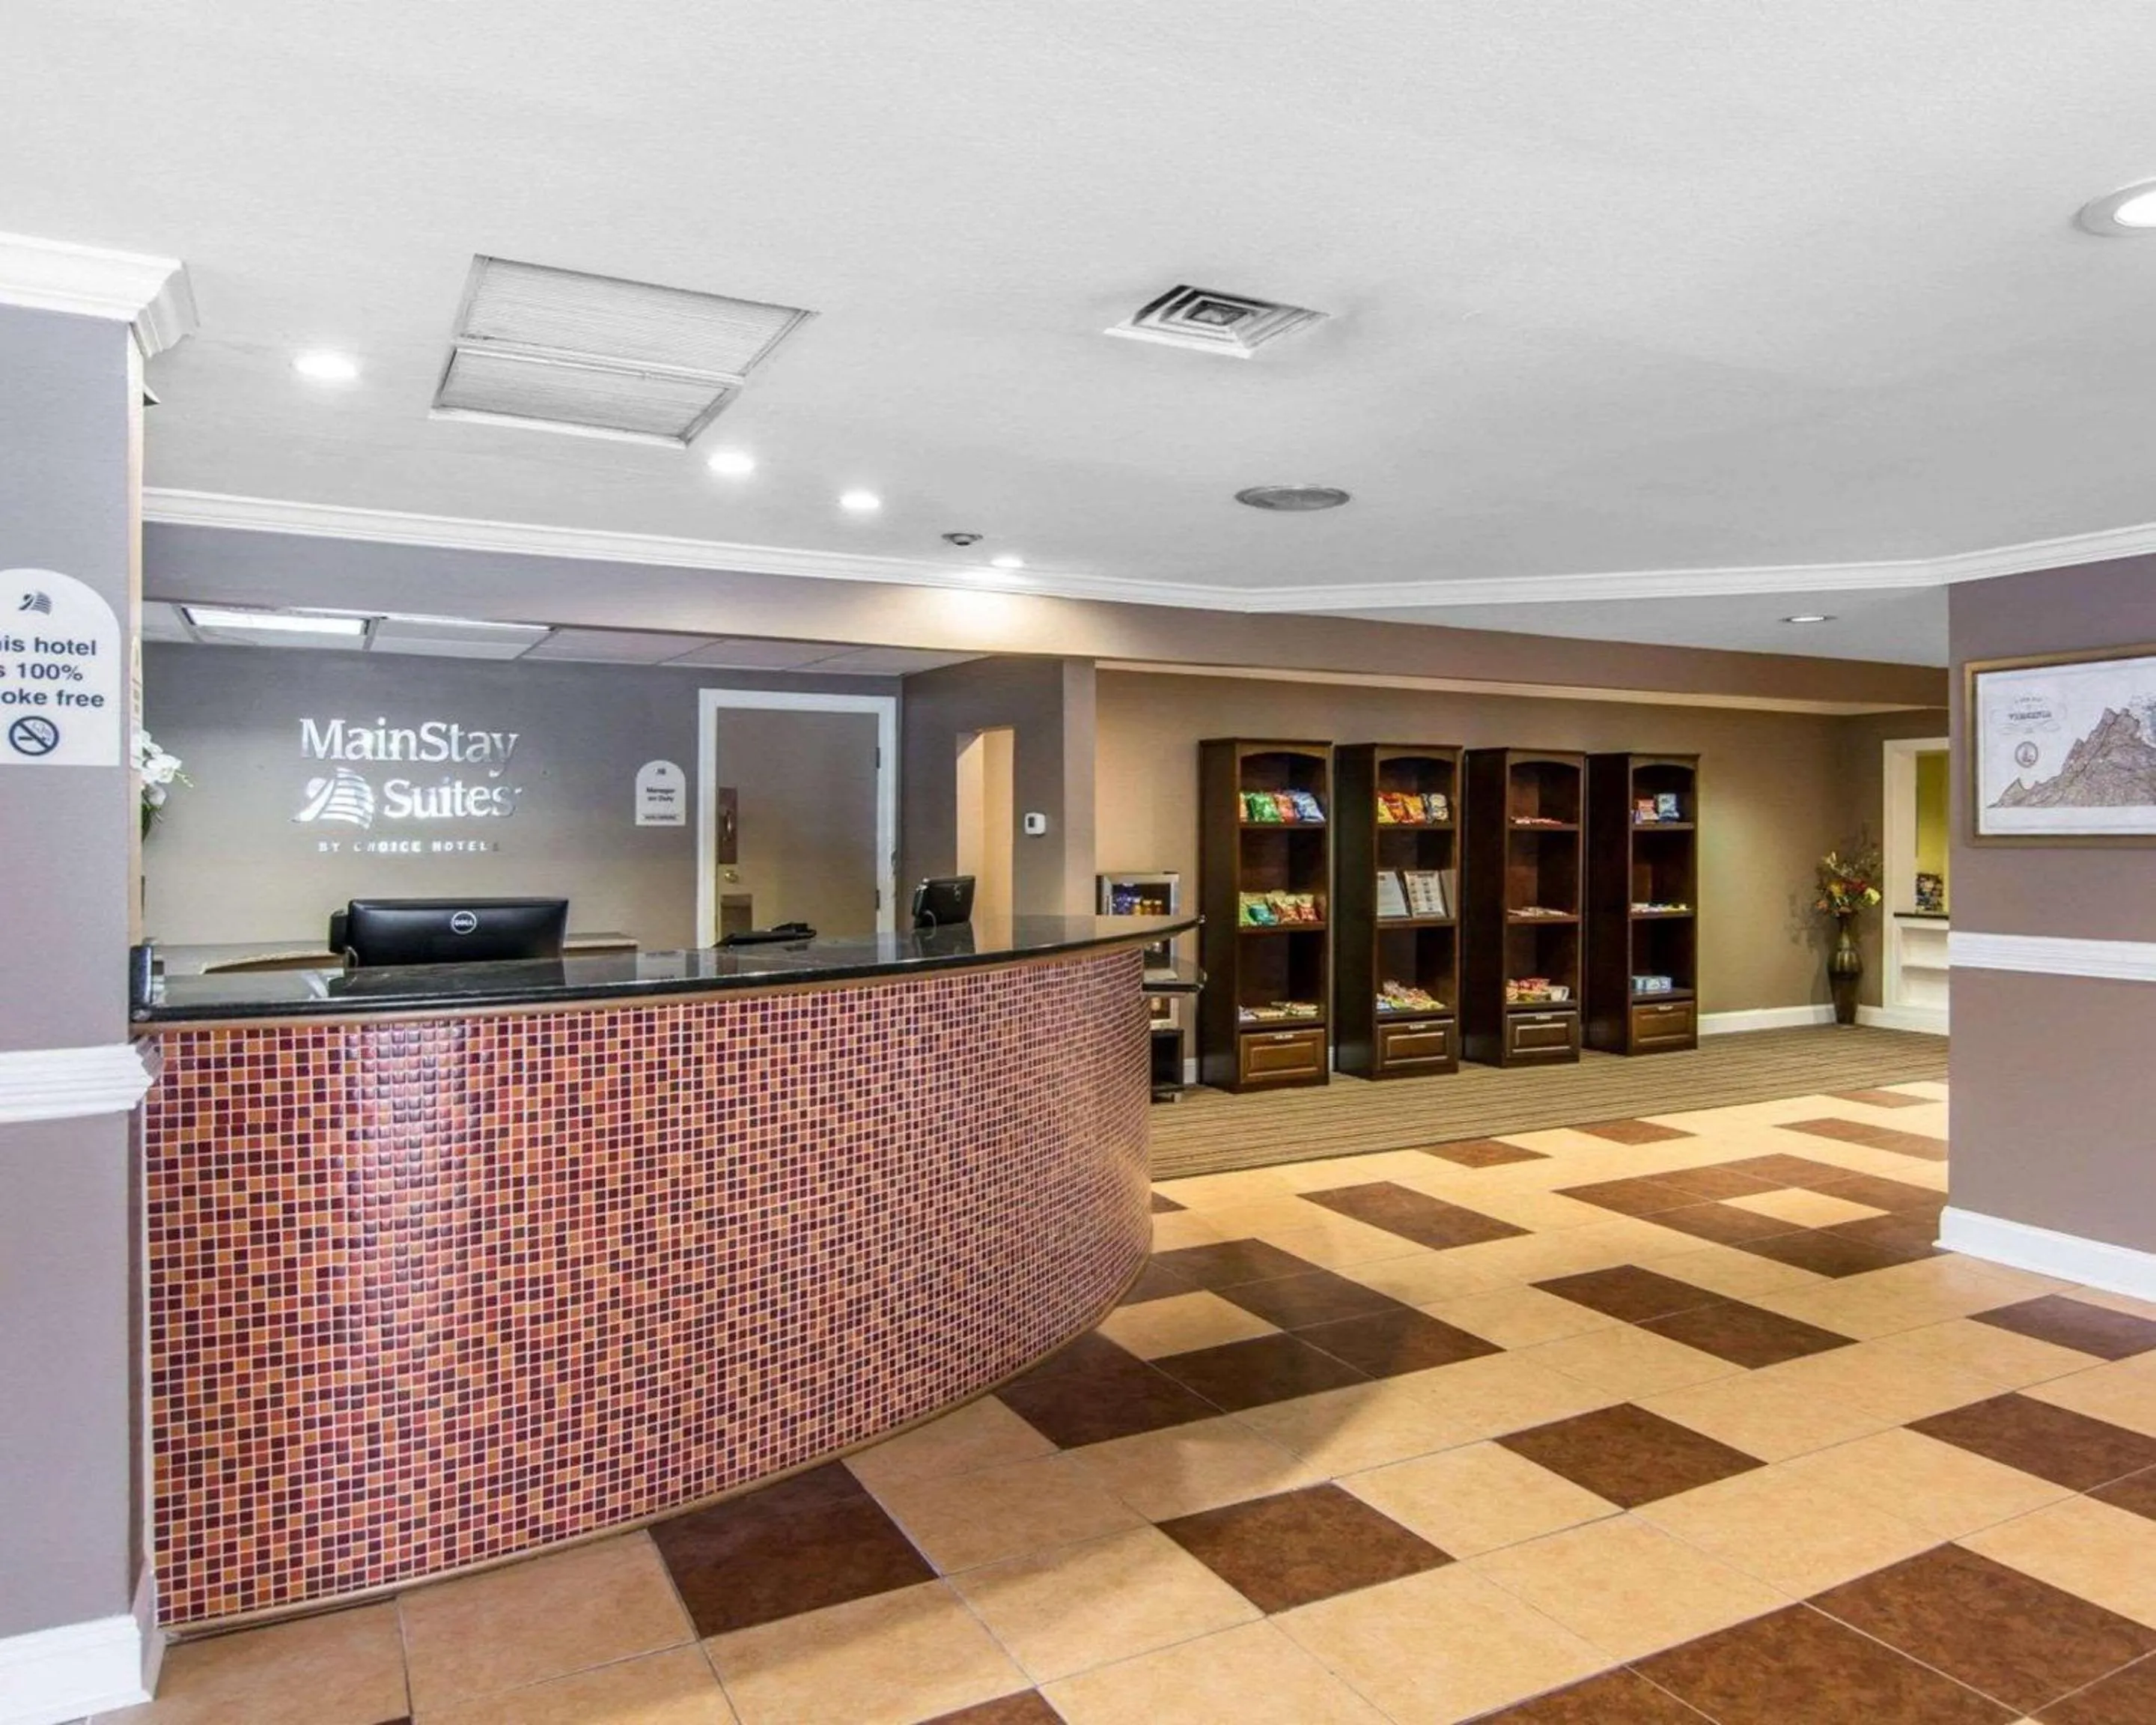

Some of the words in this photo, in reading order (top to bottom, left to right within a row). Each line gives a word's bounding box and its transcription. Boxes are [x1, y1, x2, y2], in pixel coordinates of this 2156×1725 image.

[0, 635, 25, 652] is
[34, 636, 97, 655] hotel
[16, 662, 83, 681] 100%
[57, 690, 105, 707] free
[299, 717, 520, 777] MainStay
[383, 776, 515, 818] Suites
[318, 841, 341, 852] BY
